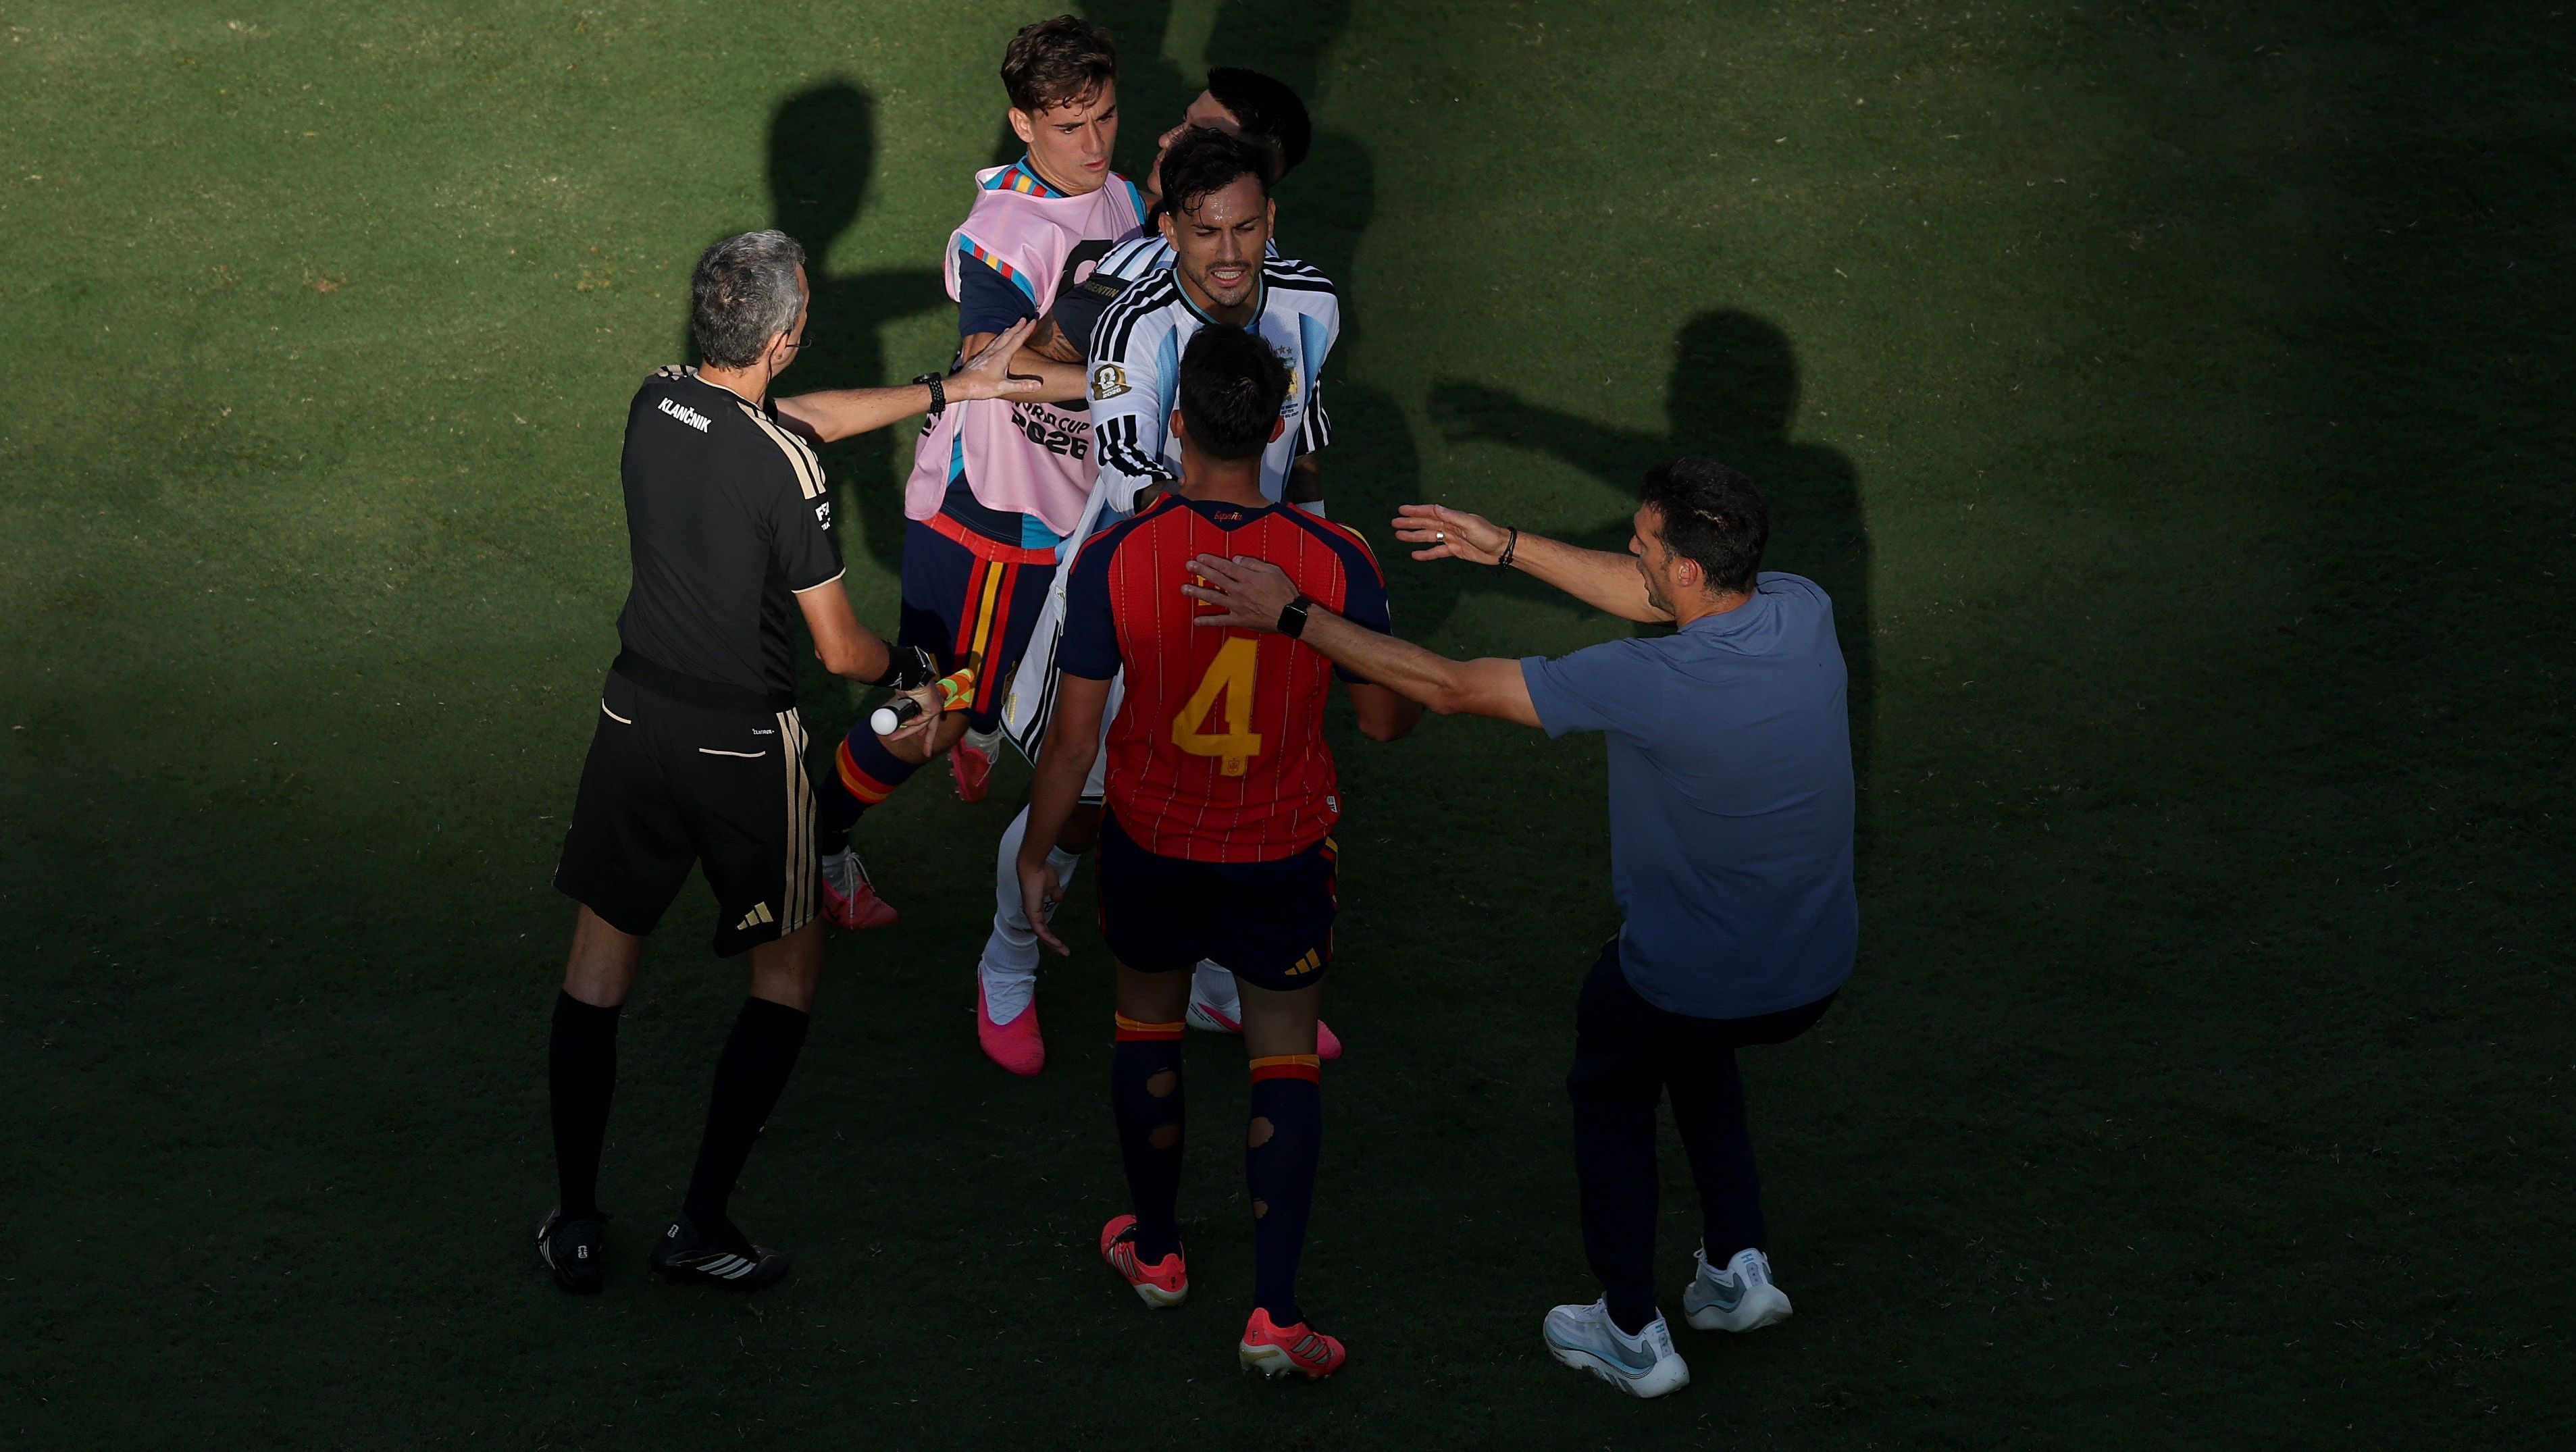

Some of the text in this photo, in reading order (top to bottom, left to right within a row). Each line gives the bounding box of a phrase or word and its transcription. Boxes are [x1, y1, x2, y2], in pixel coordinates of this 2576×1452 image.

[657, 397, 712, 433] KLANČNIK
[1058, 417, 1090, 434] CUP
[1171, 636, 1262, 777] 4
